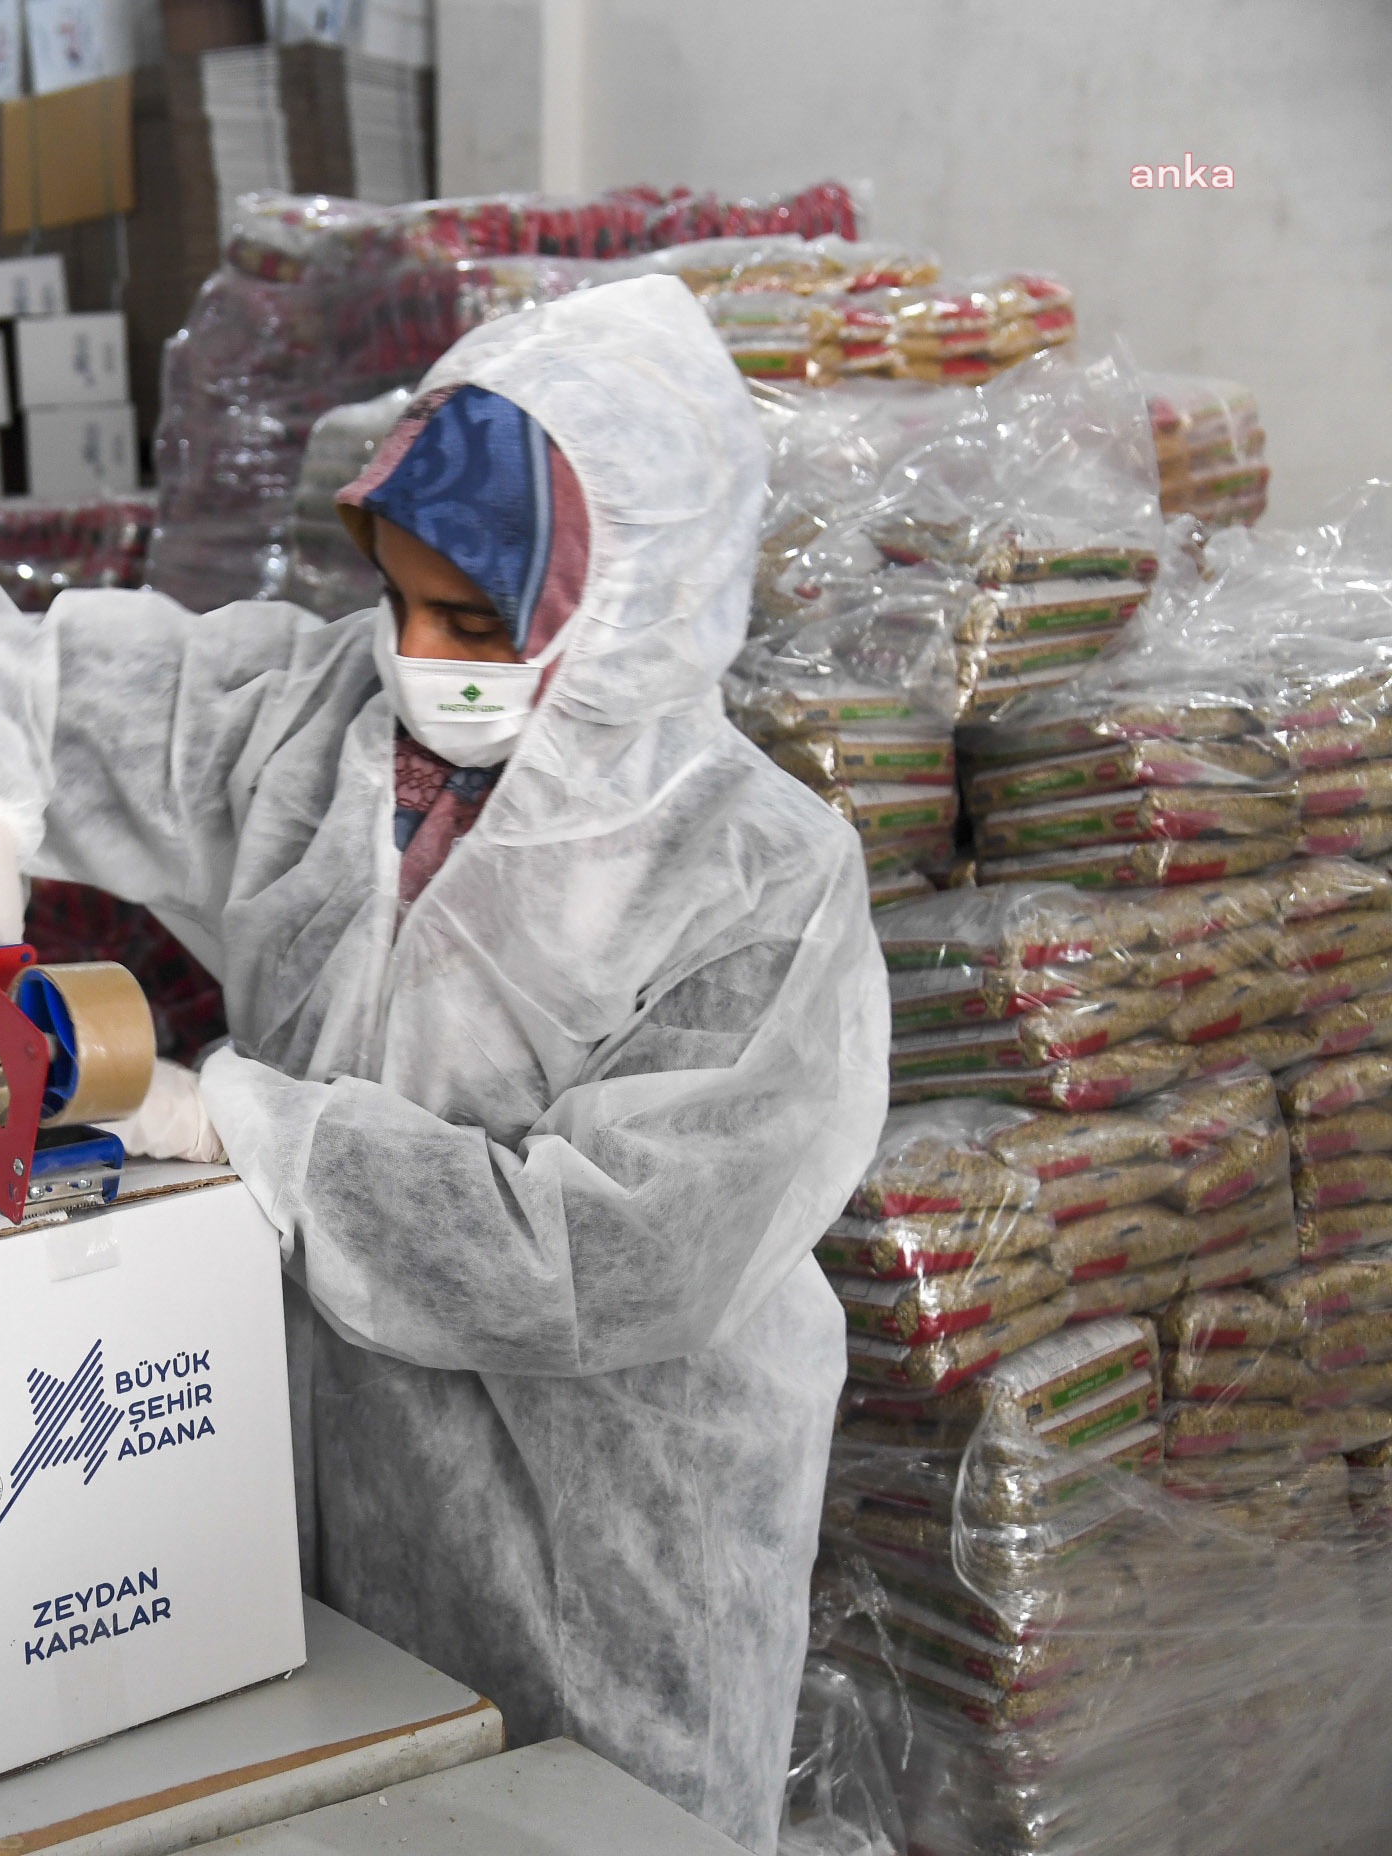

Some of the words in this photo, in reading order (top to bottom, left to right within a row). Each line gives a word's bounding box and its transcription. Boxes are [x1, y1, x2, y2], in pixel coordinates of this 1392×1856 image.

[115, 1350, 210, 1394] BÜYÜK
[127, 1380, 213, 1432] ŞEHİR
[117, 1417, 215, 1460] ADANA
[33, 1567, 159, 1629] ZEYDAN
[24, 1597, 171, 1665] KARALAR
